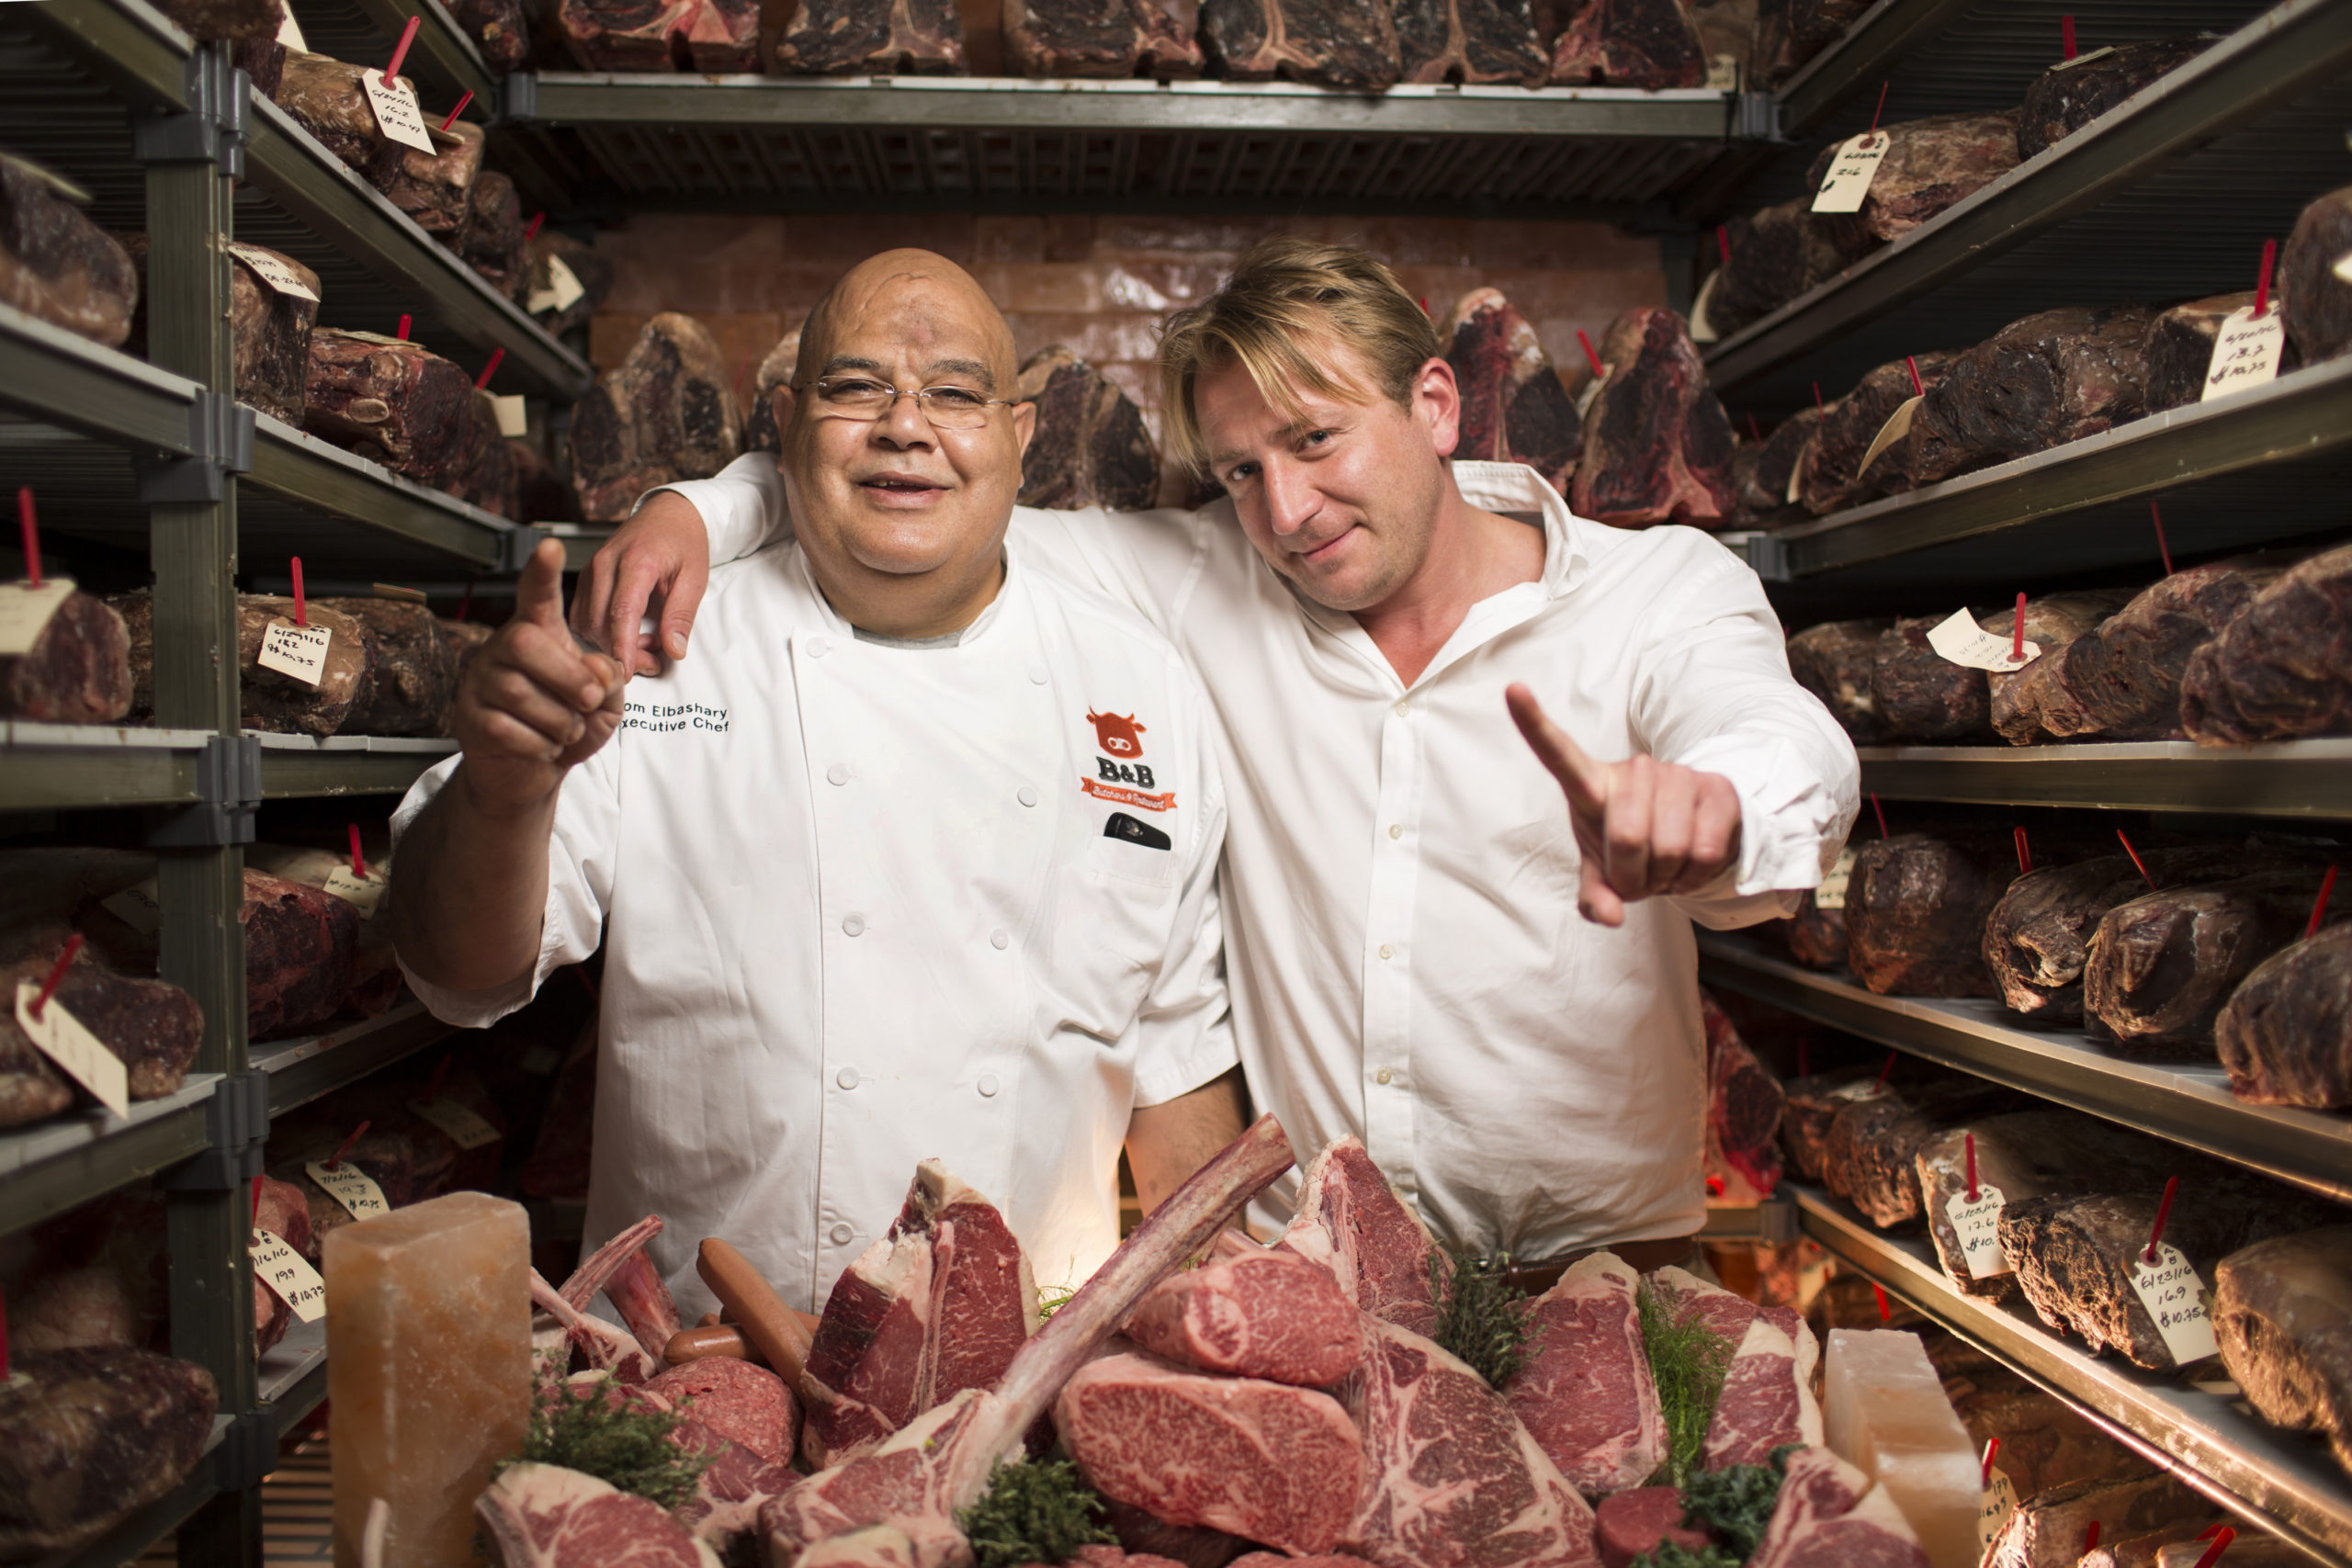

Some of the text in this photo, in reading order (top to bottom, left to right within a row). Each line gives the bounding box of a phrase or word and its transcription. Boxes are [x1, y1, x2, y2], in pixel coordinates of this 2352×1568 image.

[624, 703, 728, 720] om Elbashary
[621, 716, 729, 732] xecutive Chef
[1096, 756, 1155, 790] B&B
